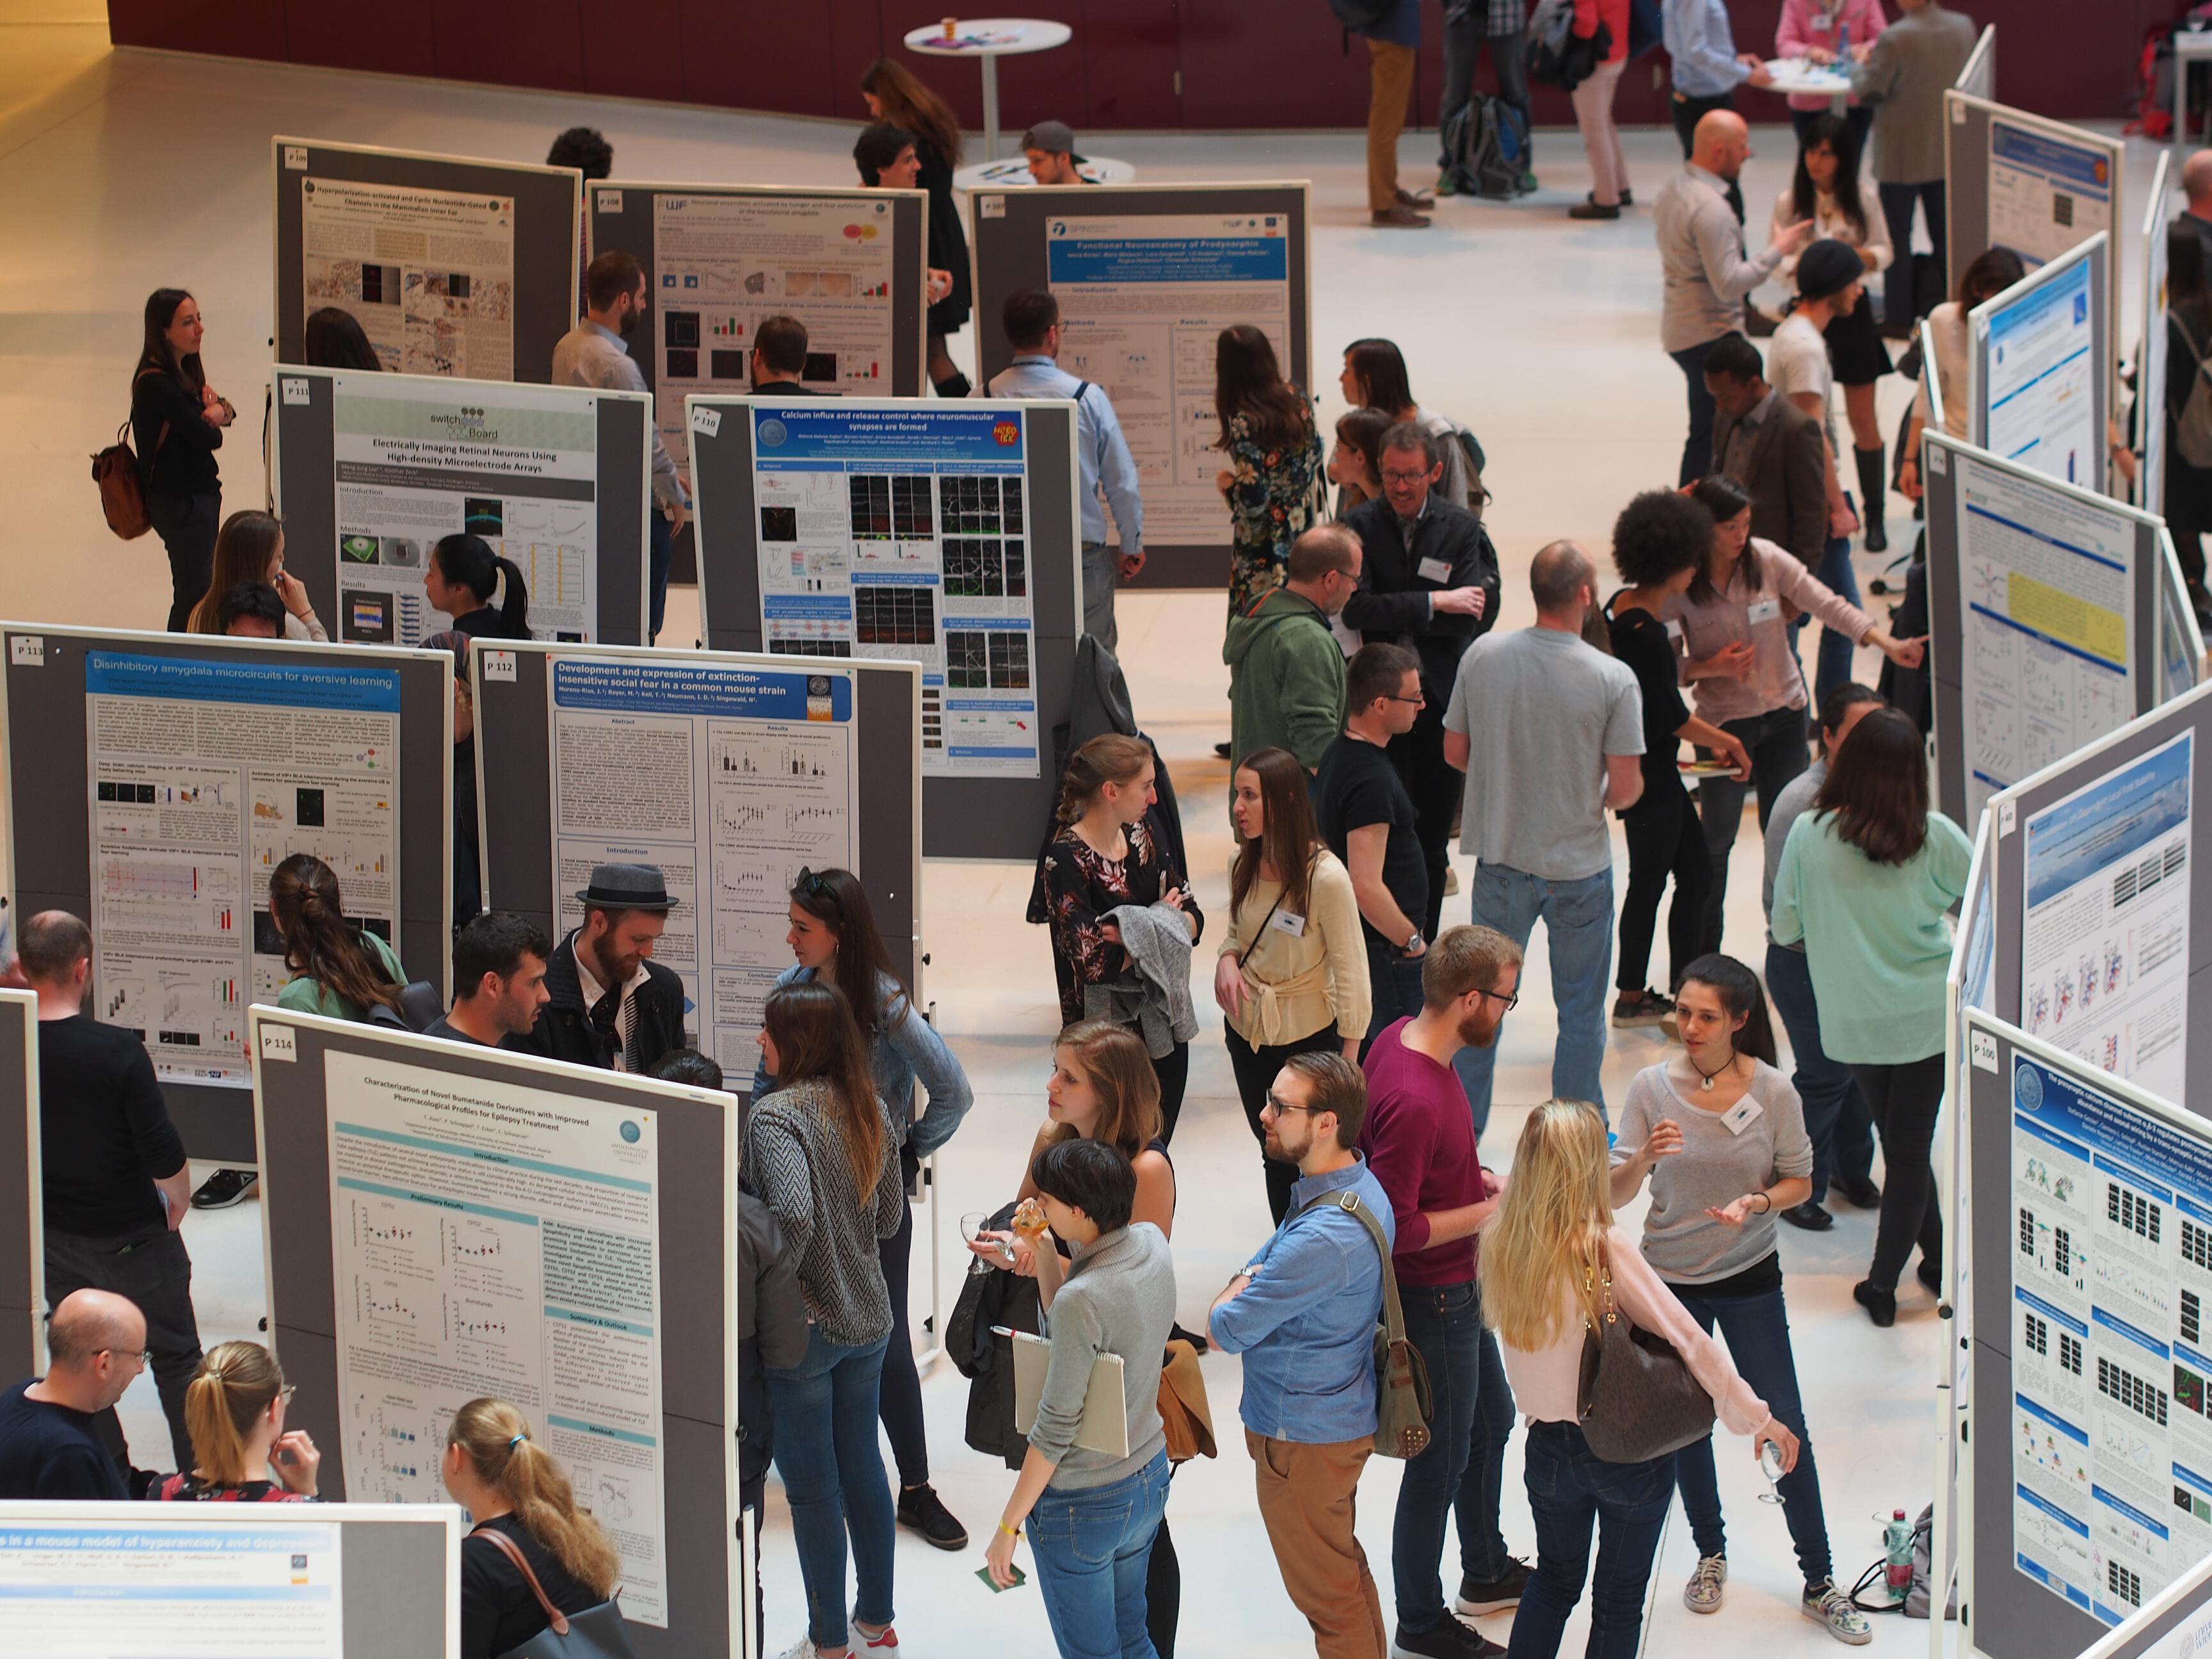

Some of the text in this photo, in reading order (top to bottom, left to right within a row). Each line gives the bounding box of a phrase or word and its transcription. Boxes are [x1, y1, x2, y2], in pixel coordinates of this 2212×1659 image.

[344, 198, 372, 207] Channels
[392, 203, 429, 212] Mammalian
[1077, 238, 1260, 249] Functional Neuroanatomy of Prodynorphin
[430, 414, 461, 424] switch
[781, 410, 994, 421] Calcium influx and release control where neuromuscular
[702, 417, 716, 427] 110
[899, 422, 927, 431] formed
[469, 428, 498, 439] Board
[373, 438, 556, 462] Electrically Imaging Retinal Neurons Using
[387, 453, 541, 473] High-density Microelectrode Arrays
[339, 486, 383, 497] Introduction
[341, 526, 371, 534] Methods
[341, 579, 365, 591] Results
[28, 647, 43, 655] 113
[497, 662, 512, 671] 112
[558, 663, 760, 682] Development and expression of extinction-
[93, 658, 392, 689] Disinhibitory amygdala microcircuits for aversive learning
[558, 674, 608, 685] insensitive
[610, 678, 637, 687] social
[639, 678, 659, 688] fear
[661, 680, 670, 689] in
[680, 683, 722, 691] common
[758, 685, 786, 695] strain
[266, 1038, 291, 1050] P 114
[1982, 1047, 1995, 1060] 100
[364, 1077, 420, 1093] Characterization
[429, 1089, 451, 1099] Novel
[451, 1094, 494, 1107] Bumetanide
[495, 1102, 535, 1116] Derivatives
[554, 1114, 589, 1125] Improved
[393, 1093, 450, 1110] Pharmacological
[451, 1104, 478, 1115] Profiles
[479, 1109, 490, 1118] for
[491, 1112, 520, 1125] Epilepsy
[521, 1118, 559, 1131] Treatment
[473, 1151, 509, 1163] Introduction
[410, 1193, 463, 1210] Preliminary Results
[570, 1313, 597, 1325] Summary
[604, 1320, 627, 1330] Outlook
[588, 1425, 614, 1436] Methods
